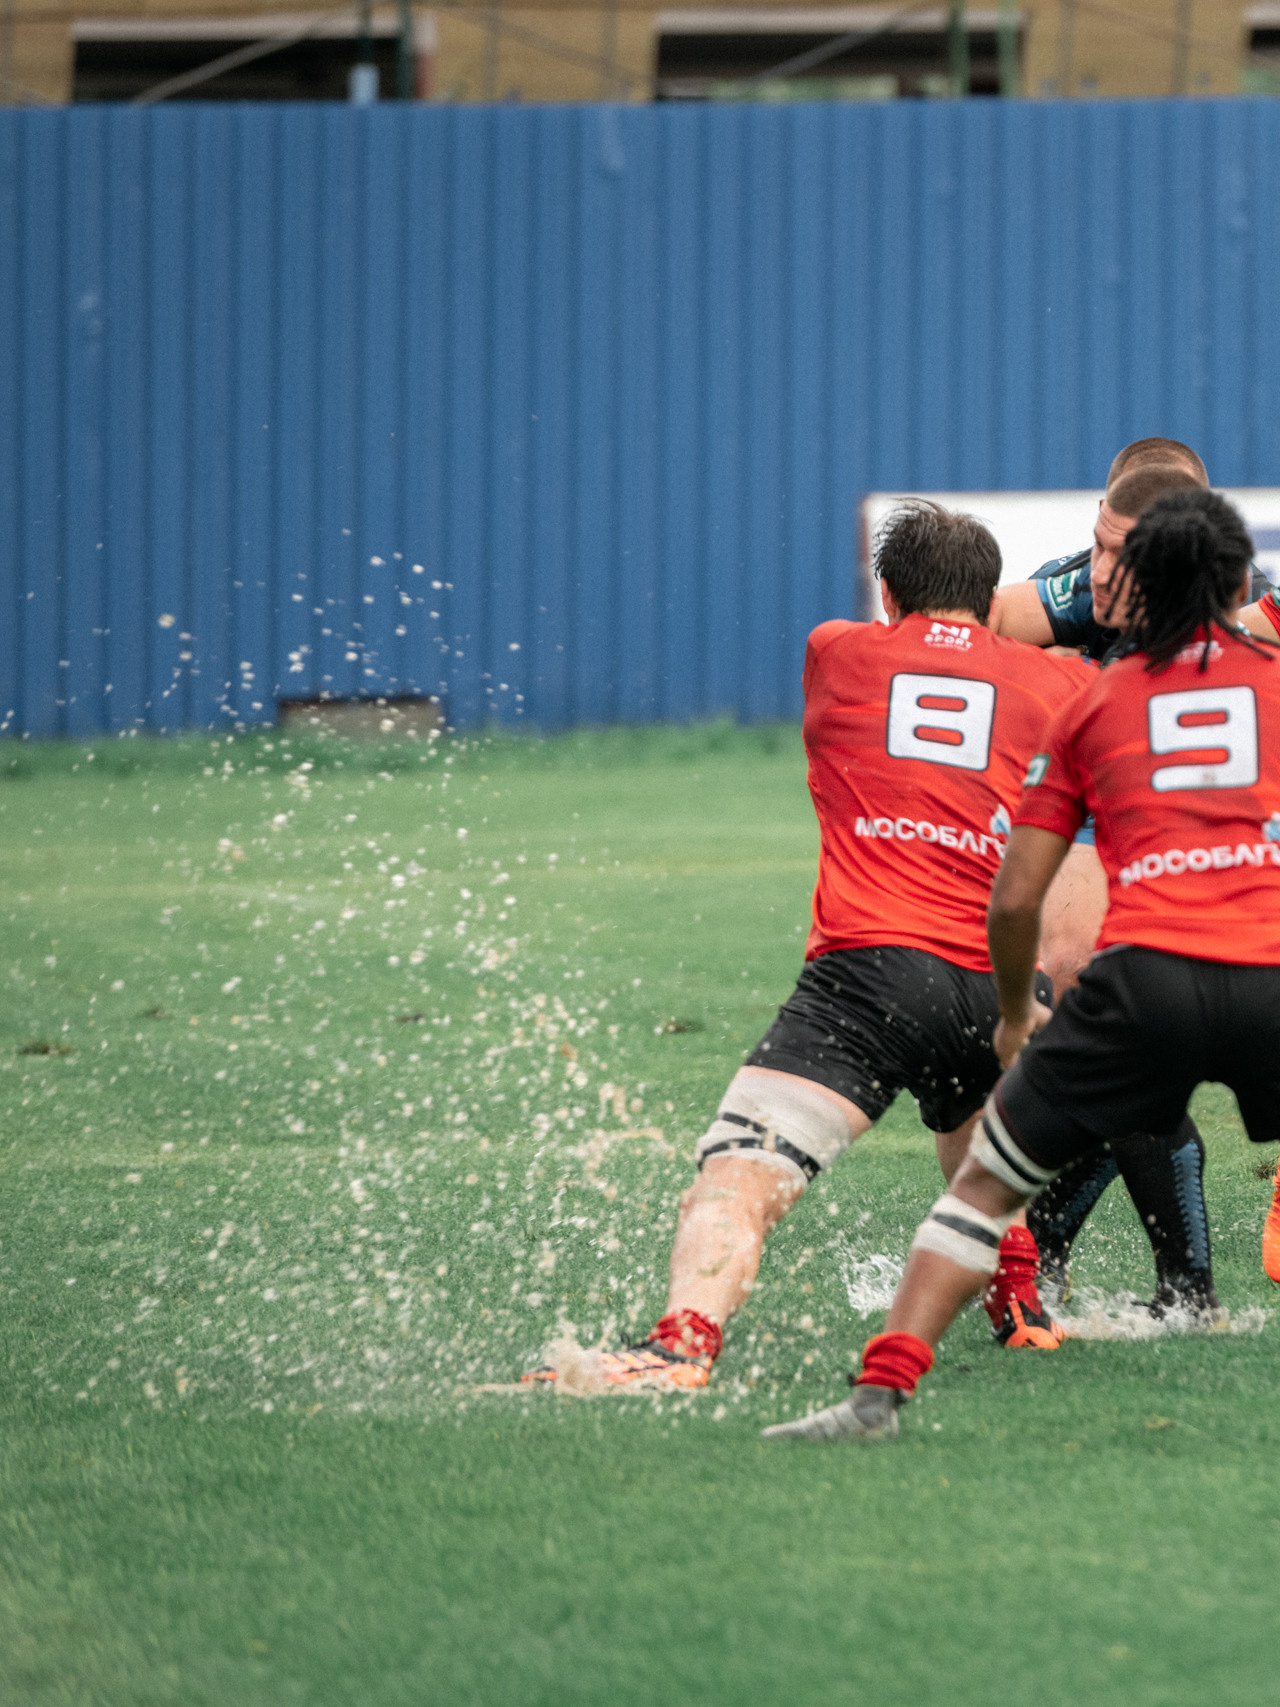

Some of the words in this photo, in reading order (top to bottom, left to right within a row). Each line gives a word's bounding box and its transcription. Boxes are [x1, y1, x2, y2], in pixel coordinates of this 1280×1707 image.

[924, 633, 973, 649] SPORT
[887, 672, 996, 771] 8
[1147, 685, 1260, 792] 9
